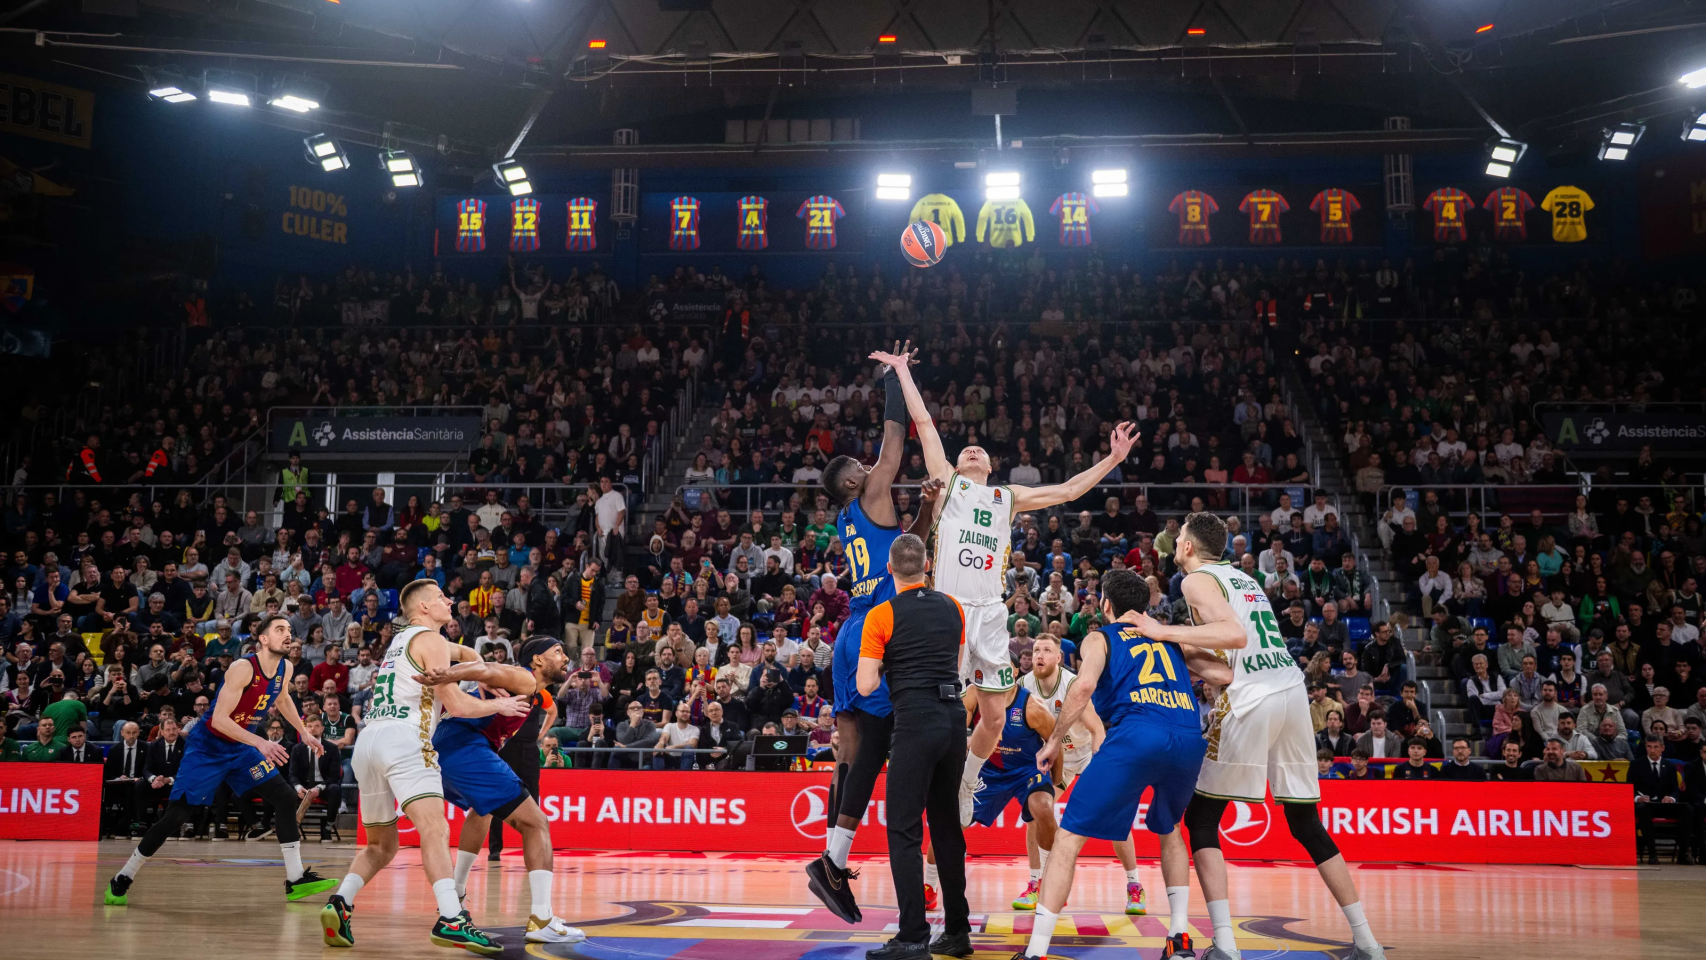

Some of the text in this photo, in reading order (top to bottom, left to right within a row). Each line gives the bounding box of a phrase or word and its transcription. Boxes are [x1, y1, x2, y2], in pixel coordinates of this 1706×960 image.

[289, 185, 347, 217] 100%
[1502, 201, 1516, 219] 2
[1555, 201, 1581, 219] 28
[570, 211, 592, 229] 11
[677, 211, 691, 228] 7
[745, 210, 760, 228] 4
[809, 209, 832, 227] 21
[931, 208, 943, 226] 1
[994, 208, 1018, 225] 16
[1063, 206, 1088, 224] 14
[1187, 204, 1200, 222] 8
[1257, 204, 1271, 221] 7
[1329, 203, 1342, 221] 5
[1442, 202, 1457, 220] 4
[282, 211, 347, 243] CULER
[460, 212, 482, 230] 15
[513, 212, 536, 230] 12
[288, 421, 307, 446] A
[1557, 417, 1579, 444] A
[973, 508, 993, 527] 18
[845, 537, 870, 583] 19
[1250, 611, 1286, 649] 15
[1129, 642, 1177, 685] 21
[998, 667, 1014, 686] 18
[373, 672, 395, 707] 51
[253, 694, 271, 710] 13
[596, 796, 747, 825] AIRLINES
[1450, 809, 1611, 837] AIRLINES
[905, 943, 926, 951] HOKA
